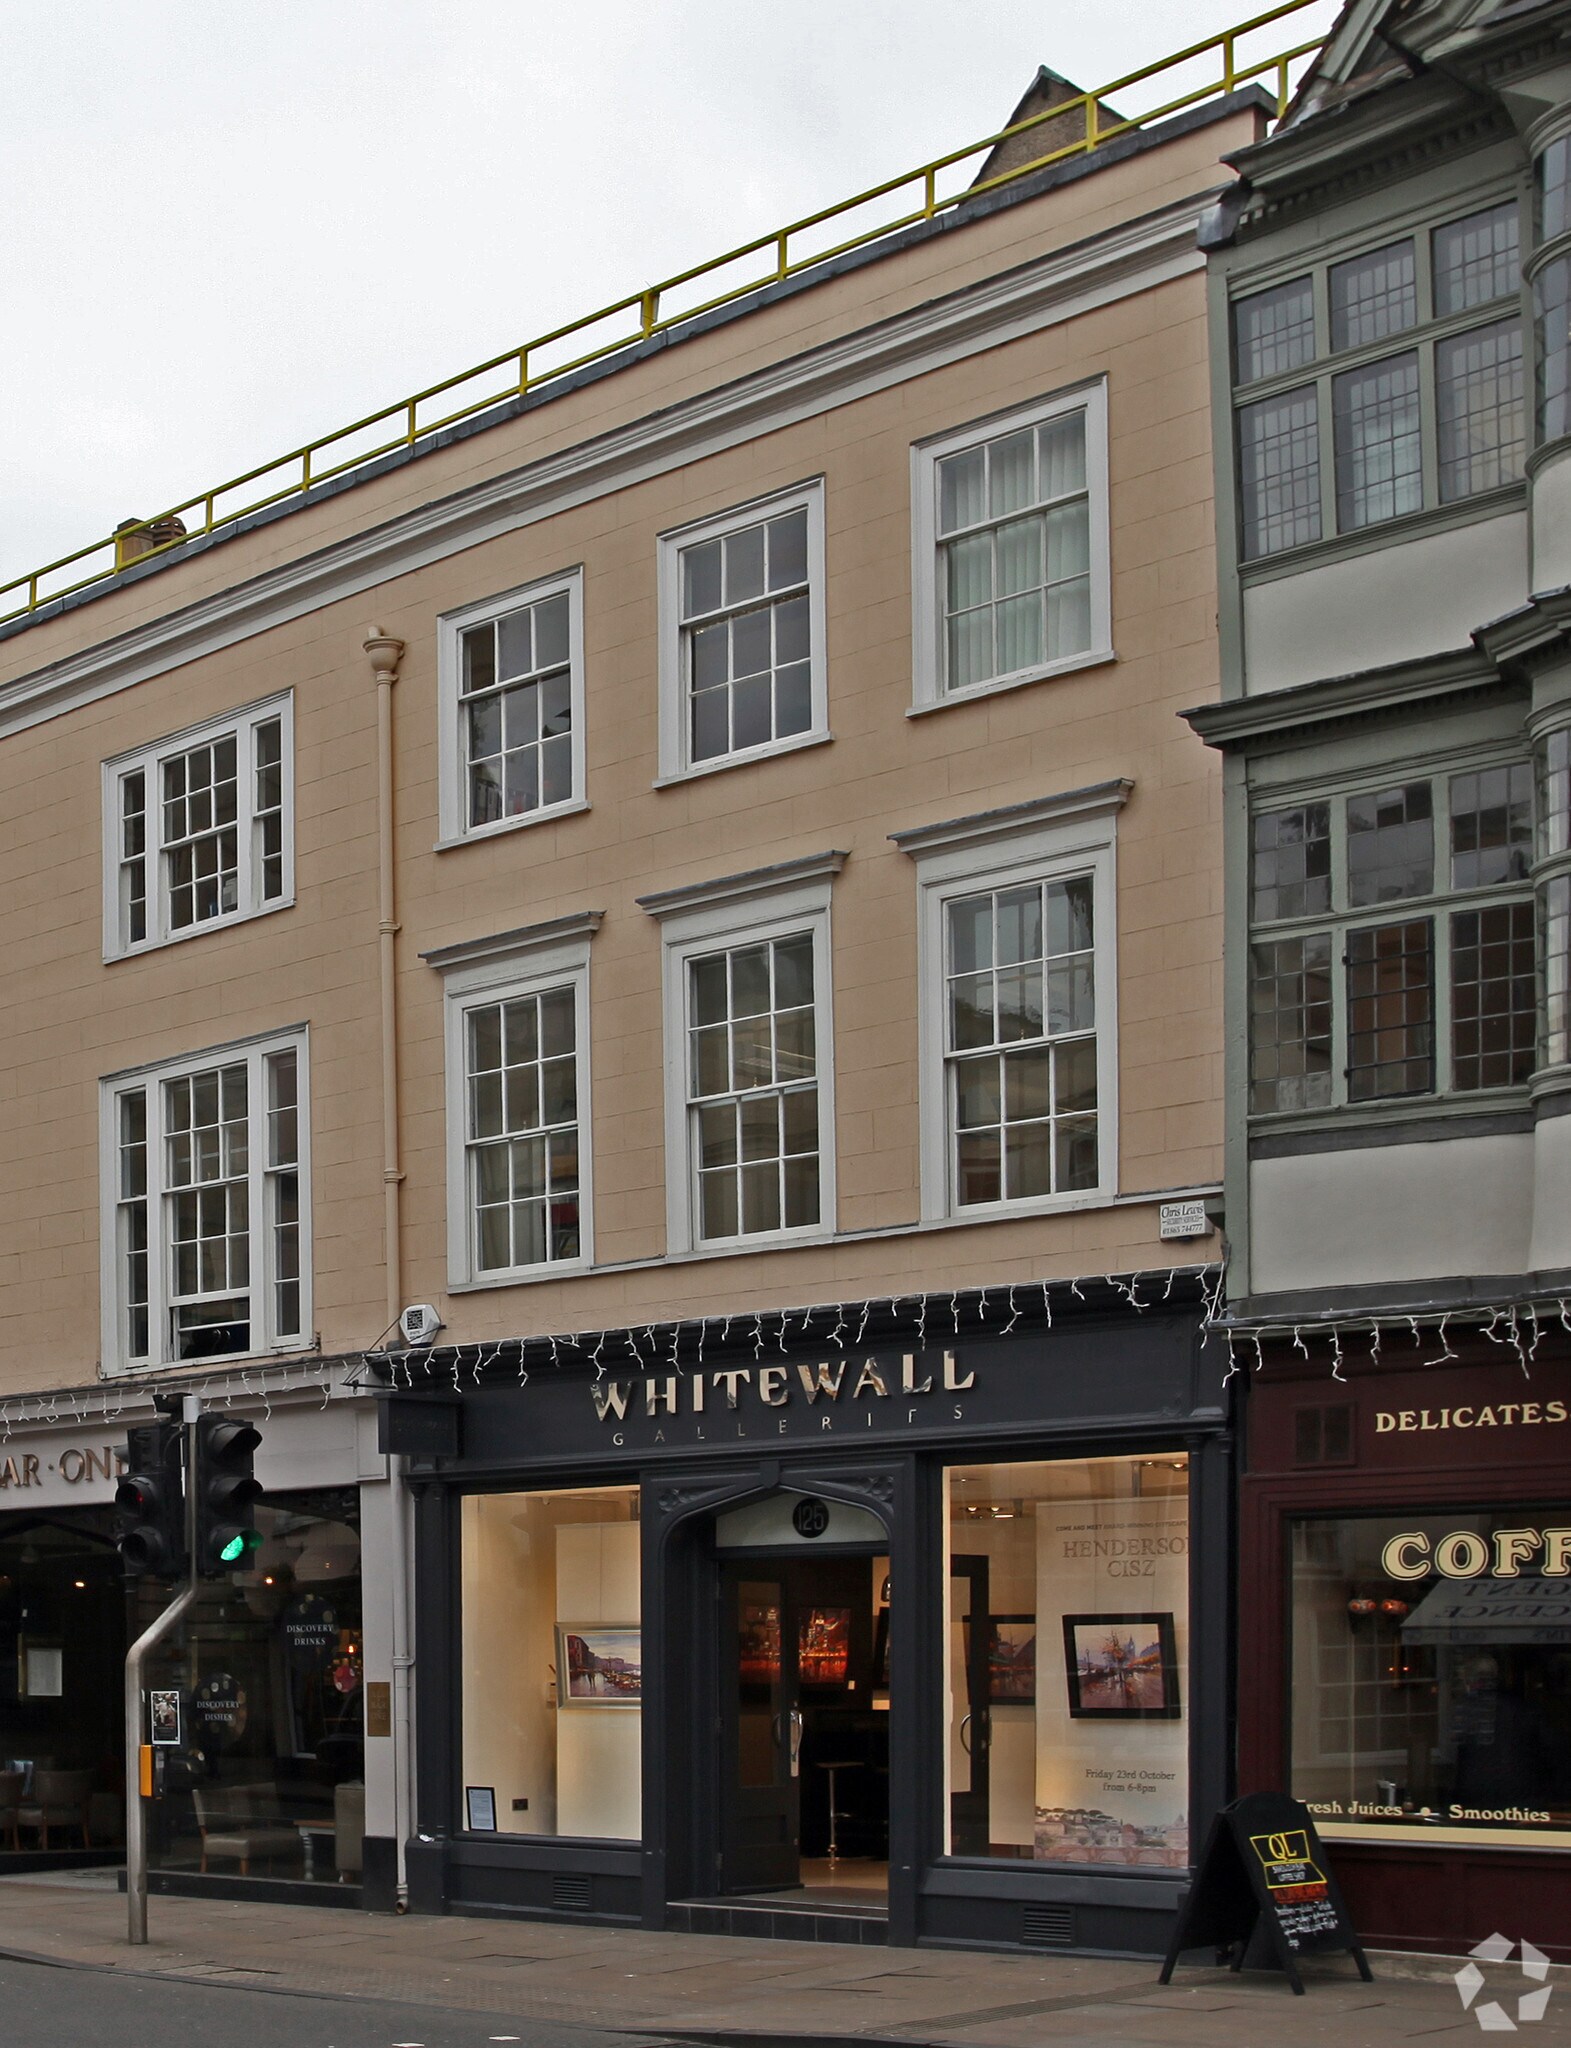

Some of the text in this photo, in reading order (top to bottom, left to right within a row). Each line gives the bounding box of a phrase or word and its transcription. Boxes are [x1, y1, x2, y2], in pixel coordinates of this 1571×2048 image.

[589, 1349, 976, 1422] WHITEWALL
[1375, 1401, 1571, 1433] DELICATES
[1062, 1536, 1189, 1559] HENDERSO
[1106, 1559, 1156, 1578] CISZ
[286, 1623, 334, 1633] DISCOVERY
[294, 1637, 326, 1646] DRINKS
[196, 1700, 240, 1709] DISCOVERY
[204, 1713, 234, 1722] DISHES
[1085, 1768, 1176, 1781] Friday 23rd October
[1102, 1782, 1157, 1795] from 6-8pm
[1296, 1800, 1551, 1822] resh Juices Smoothies
[1268, 1832, 1298, 1861] QL
